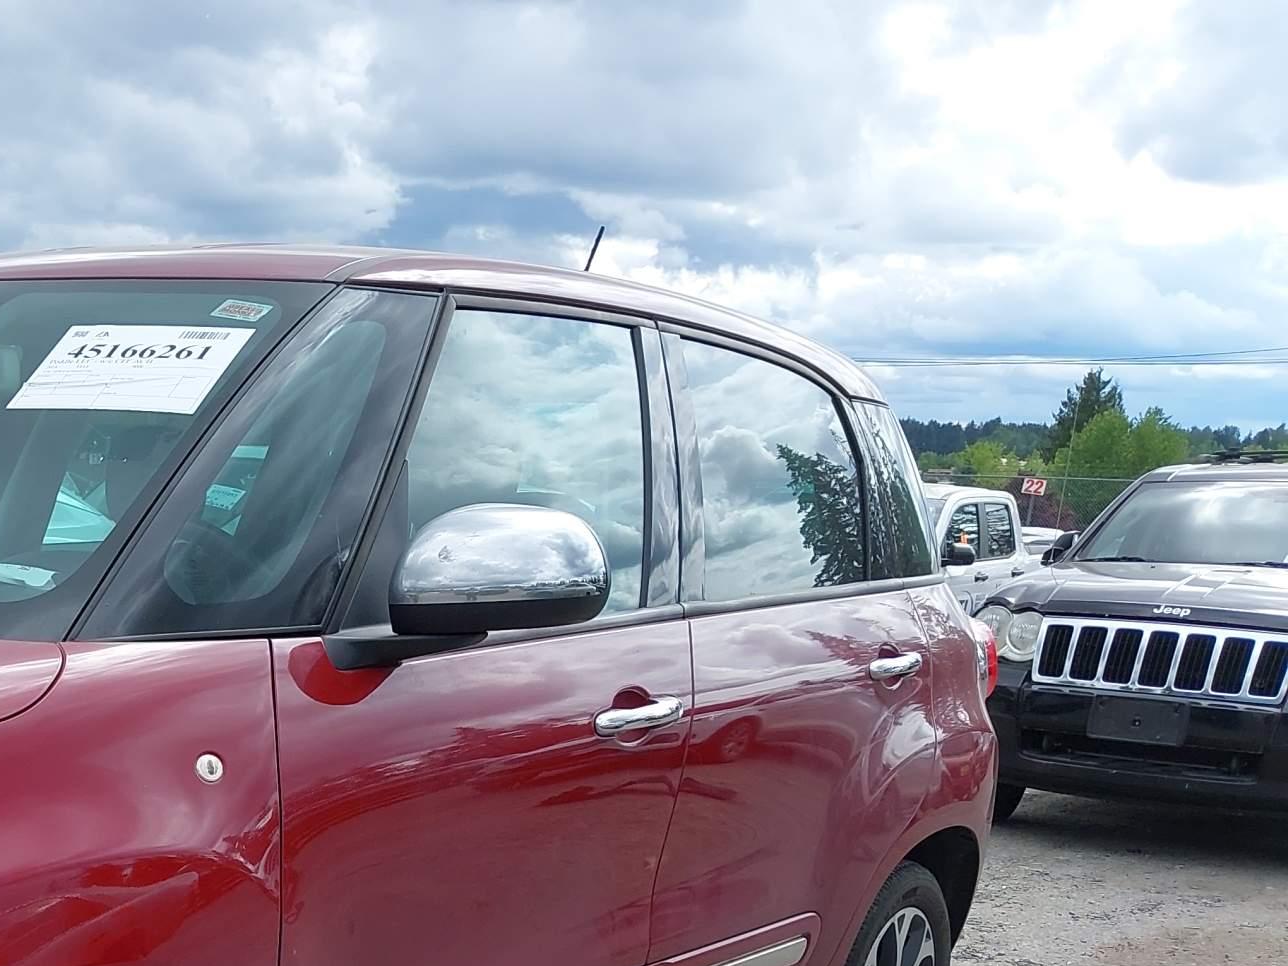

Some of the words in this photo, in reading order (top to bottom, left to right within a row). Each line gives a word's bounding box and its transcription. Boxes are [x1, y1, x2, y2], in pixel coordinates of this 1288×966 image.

[67, 344, 212, 360] 45166261
[1023, 479, 1044, 494] 22
[1152, 603, 1192, 617] Jeep
